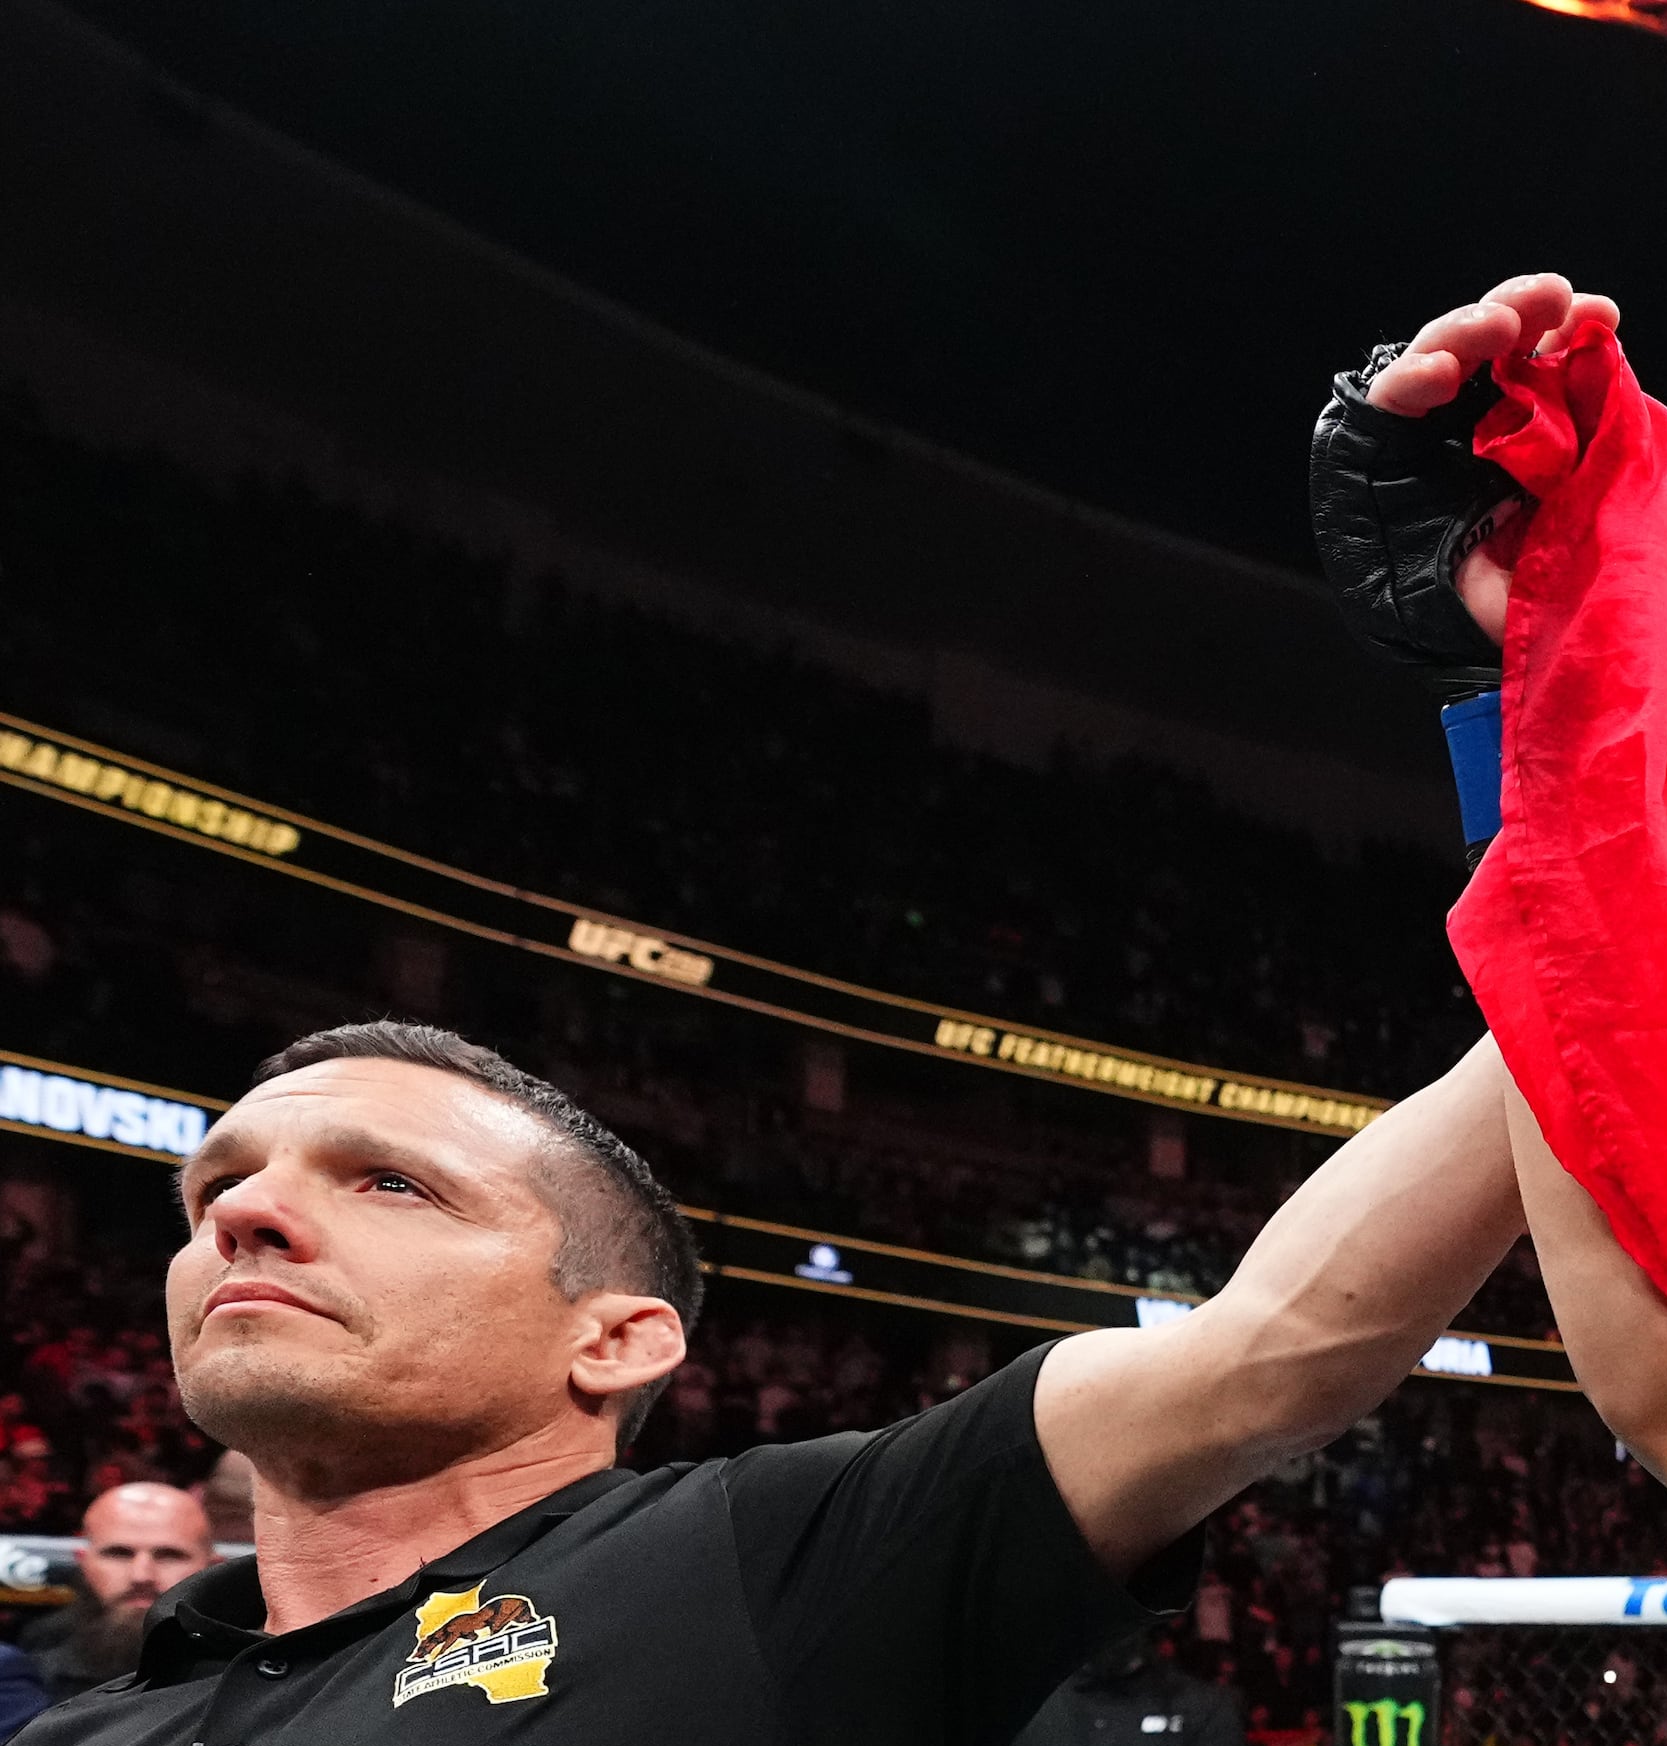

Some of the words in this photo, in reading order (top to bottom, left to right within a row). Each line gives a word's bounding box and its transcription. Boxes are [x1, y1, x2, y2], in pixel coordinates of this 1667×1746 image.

[935, 1019, 996, 1056] UFC
[401, 1623, 550, 1692] CSAC
[423, 1666, 476, 1691] ATHLETIC
[476, 1646, 552, 1672] COMMISSION
